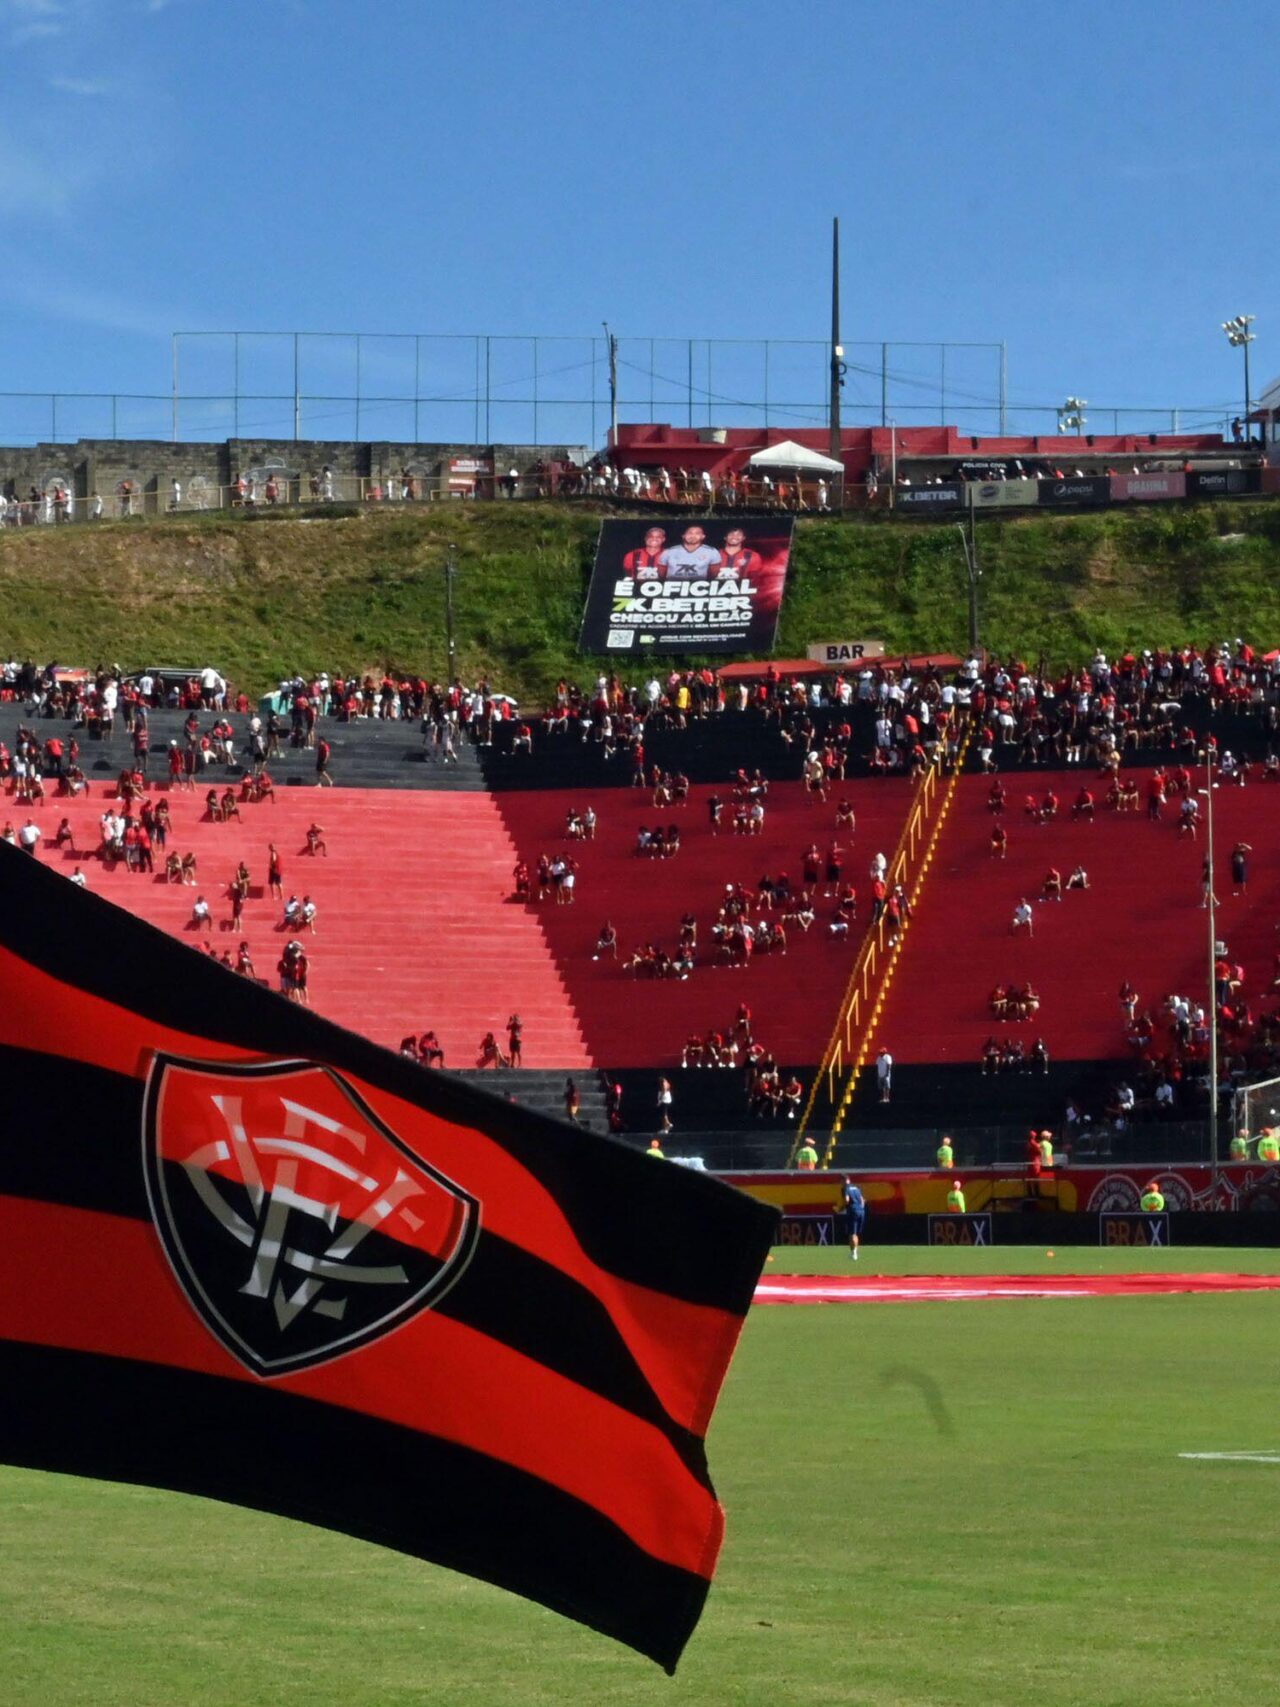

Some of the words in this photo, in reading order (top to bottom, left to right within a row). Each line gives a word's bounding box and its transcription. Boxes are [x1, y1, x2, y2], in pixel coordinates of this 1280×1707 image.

[1067, 485, 1094, 495] pepsi
[614, 576, 635, 596] É
[640, 578, 758, 597] OFICIAL
[609, 612, 679, 624] CHEGOU
[680, 612, 706, 623] AO
[708, 608, 753, 622] LEÃO
[826, 644, 865, 660] BAR
[782, 1222, 828, 1246] BRAX
[934, 1221, 986, 1246] BRAX
[1105, 1219, 1163, 1247] BRAX
